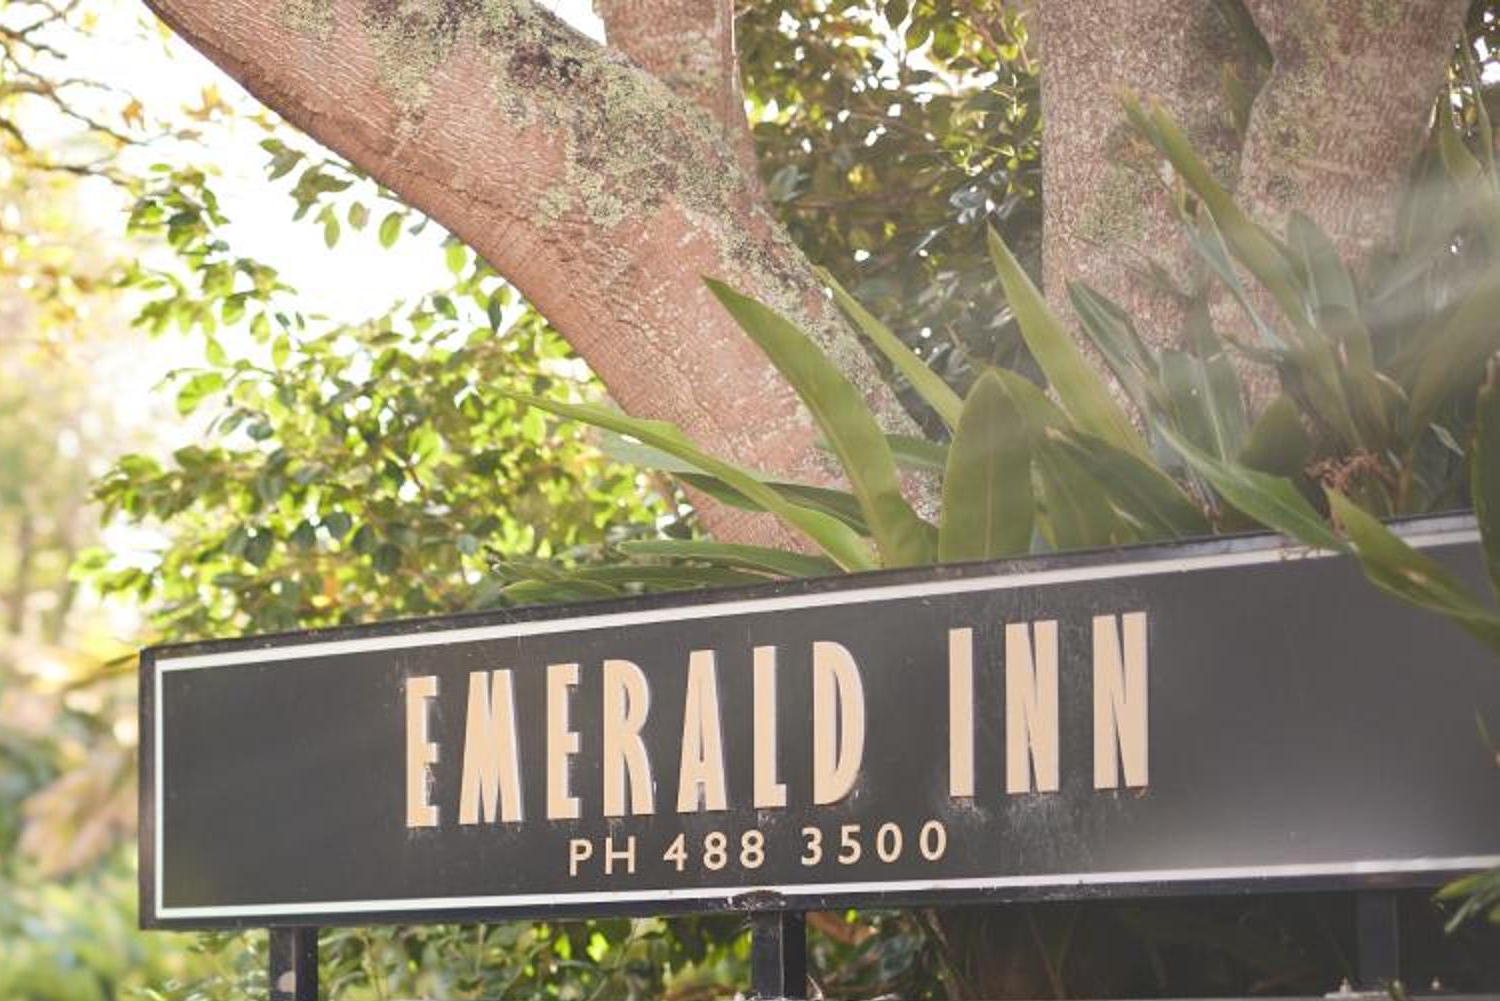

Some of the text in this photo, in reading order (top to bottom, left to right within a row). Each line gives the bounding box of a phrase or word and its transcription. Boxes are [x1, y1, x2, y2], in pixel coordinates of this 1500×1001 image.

[405, 610, 1149, 828] EMERALD INN
[569, 820, 948, 877] PH 488 3500
